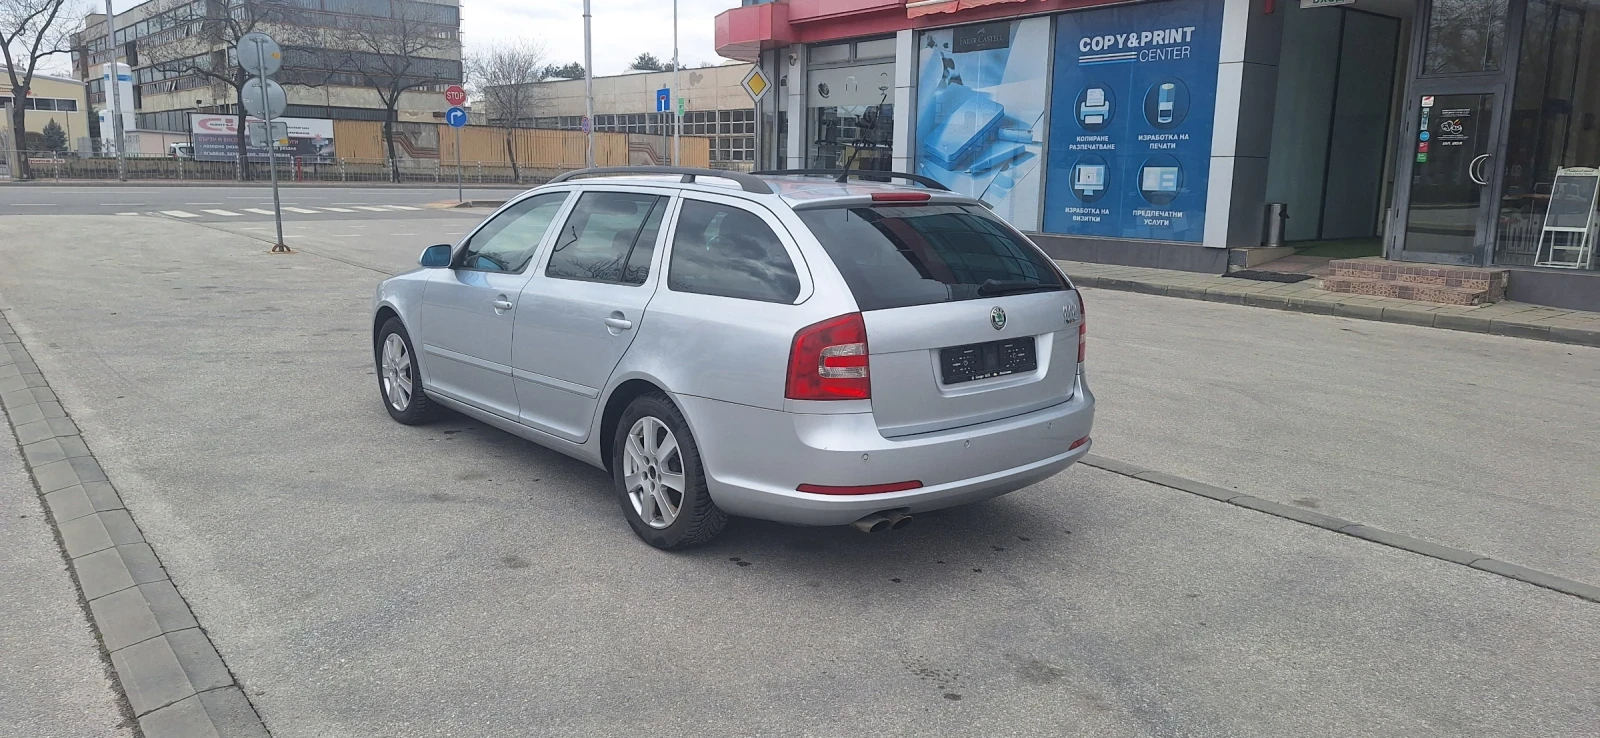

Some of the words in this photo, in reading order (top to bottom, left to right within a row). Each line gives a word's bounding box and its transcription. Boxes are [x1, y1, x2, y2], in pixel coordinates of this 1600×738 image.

[1079, 26, 1196, 52] COPY&PRINT
[1139, 45, 1191, 62] CENTER
[446, 91, 464, 100] STOP
[1149, 142, 1176, 150] ПЕЧАТИ
[1132, 210, 1183, 218] ПРЕДПЕЧАТНИ
